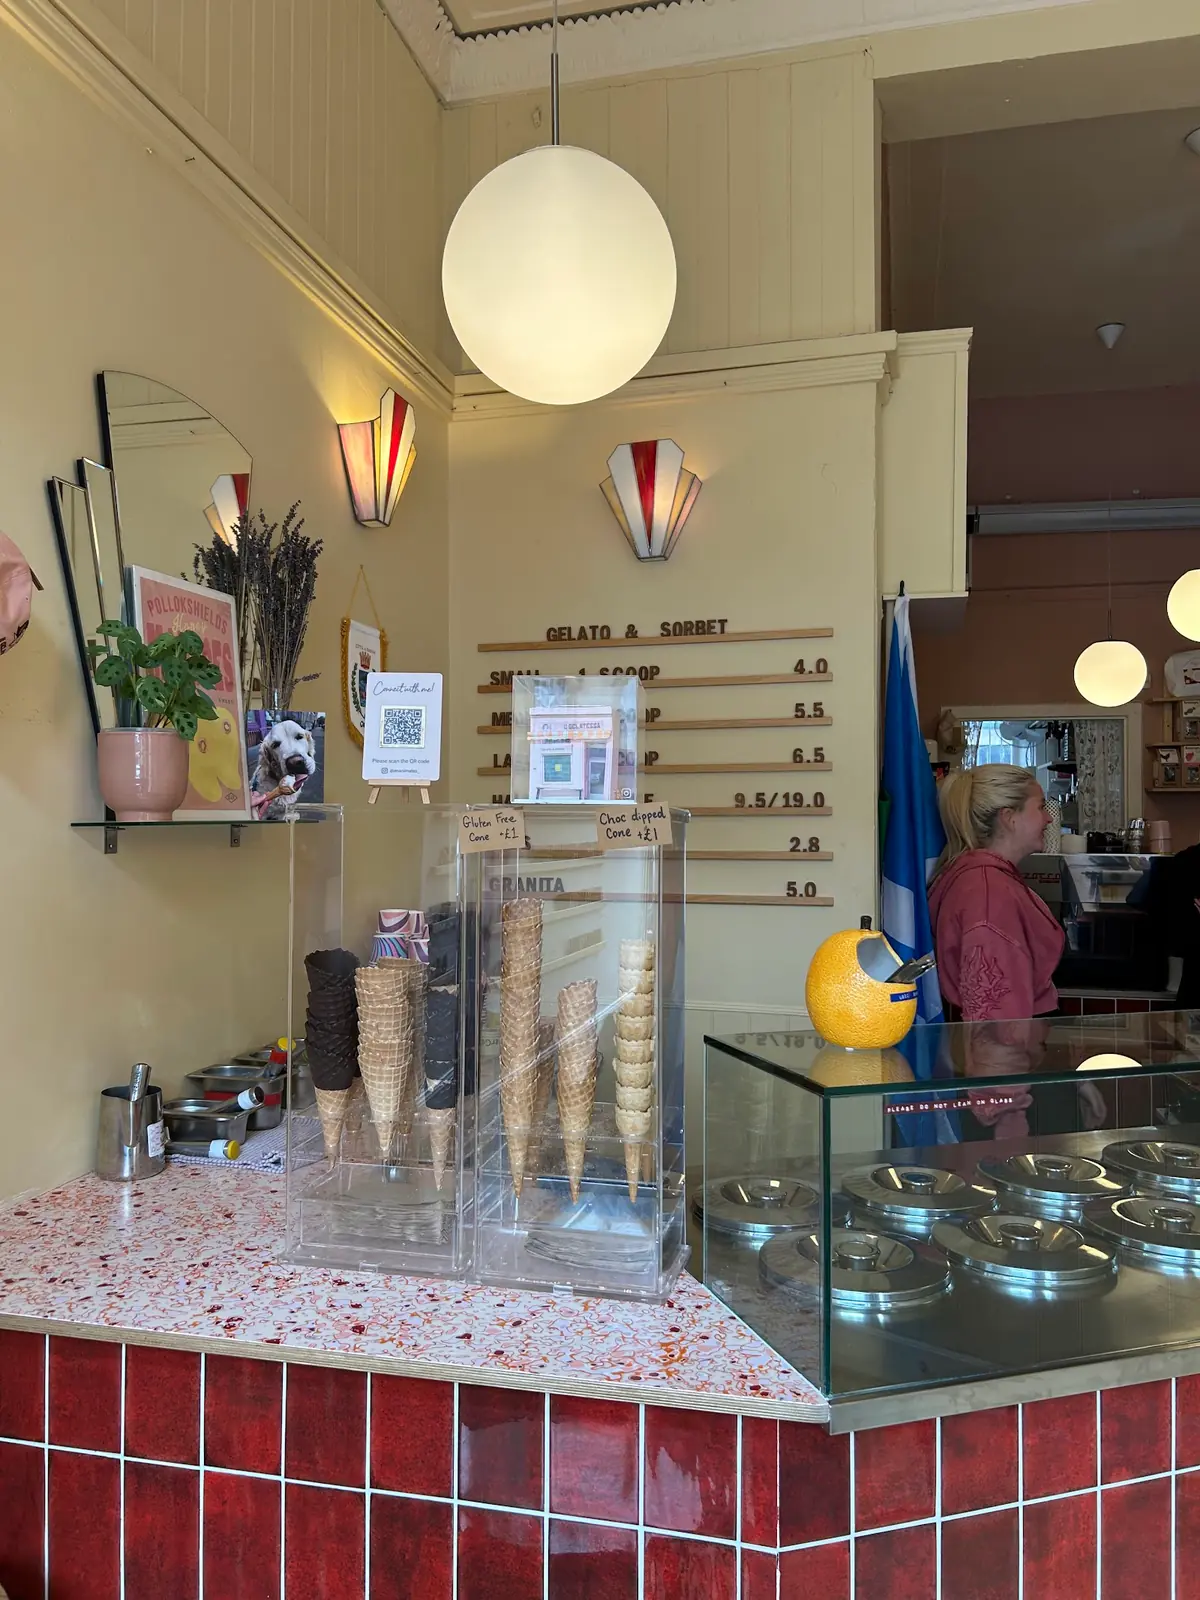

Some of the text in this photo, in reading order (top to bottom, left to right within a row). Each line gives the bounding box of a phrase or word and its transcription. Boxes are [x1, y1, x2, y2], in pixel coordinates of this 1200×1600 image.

[147, 595, 228, 635] POLLOKSHIELDS
[546, 619, 728, 641] GELATO & SORBET
[793, 657, 828, 674] 4.0
[373, 680, 405, 696] Connect
[794, 701, 824, 719] 5.5
[792, 747, 825, 764] 6.5
[734, 791, 825, 808] 9.5/19.0
[462, 812, 517, 828] Gluten Free
[599, 806, 666, 825] Choc dipped
[469, 832, 490, 842] Cone
[606, 827, 631, 839] Cone
[789, 836, 820, 852] 2.8
[489, 876, 817, 897] GRANITA 5.0
[887, 1105, 914, 1113] PLEASE
